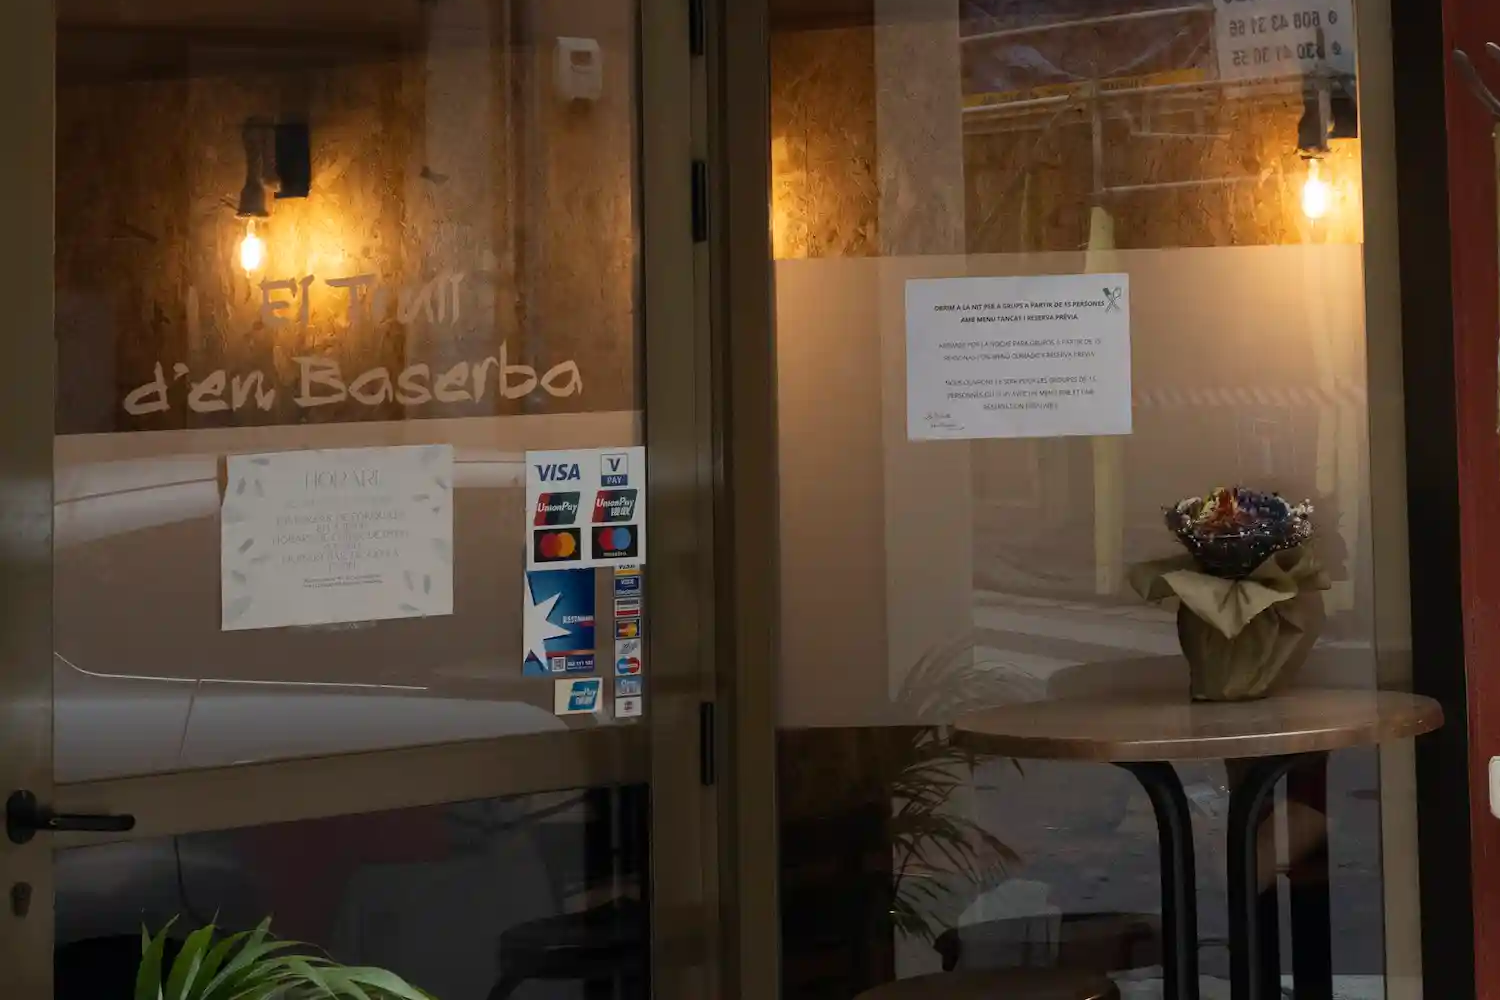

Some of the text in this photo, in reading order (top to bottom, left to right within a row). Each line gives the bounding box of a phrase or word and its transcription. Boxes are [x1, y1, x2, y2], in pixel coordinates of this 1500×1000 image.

[257, 274, 314, 327] El
[124, 340, 585, 417] d'en Baserba
[534, 458, 621, 482] VISA V
[606, 475, 623, 485] PAY
[537, 496, 635, 515] UnionPay UnionPay
